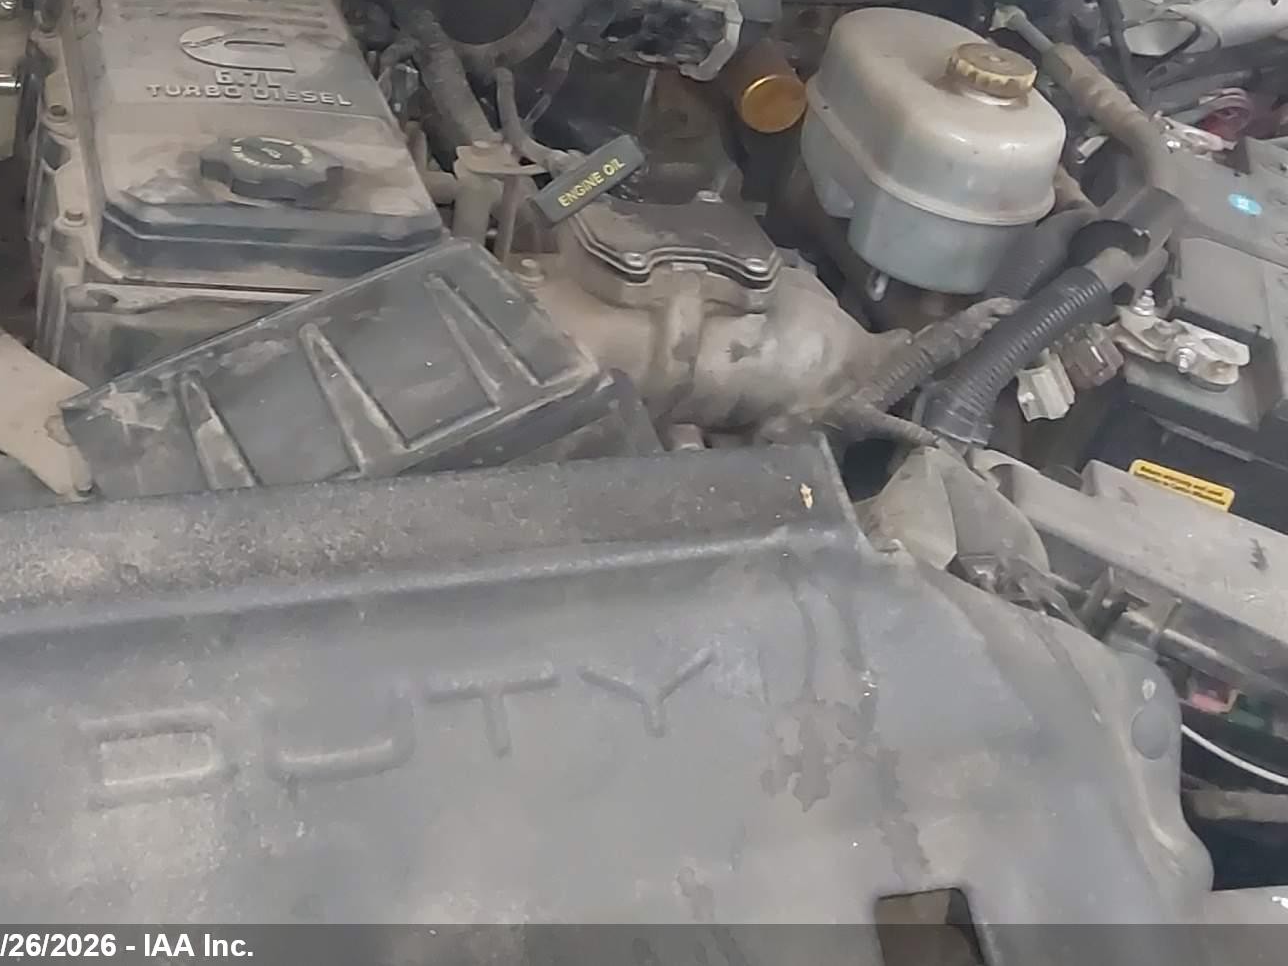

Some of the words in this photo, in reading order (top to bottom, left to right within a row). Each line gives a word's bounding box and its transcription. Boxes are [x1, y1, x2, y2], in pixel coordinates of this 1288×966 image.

[147, 83, 242, 99] TURBO
[251, 86, 352, 107] DIESEL
[216, 70, 280, 88] 6.7L
[557, 171, 605, 207] ENGINE
[602, 158, 626, 176] OIL
[77, 644, 716, 809] DUTY
